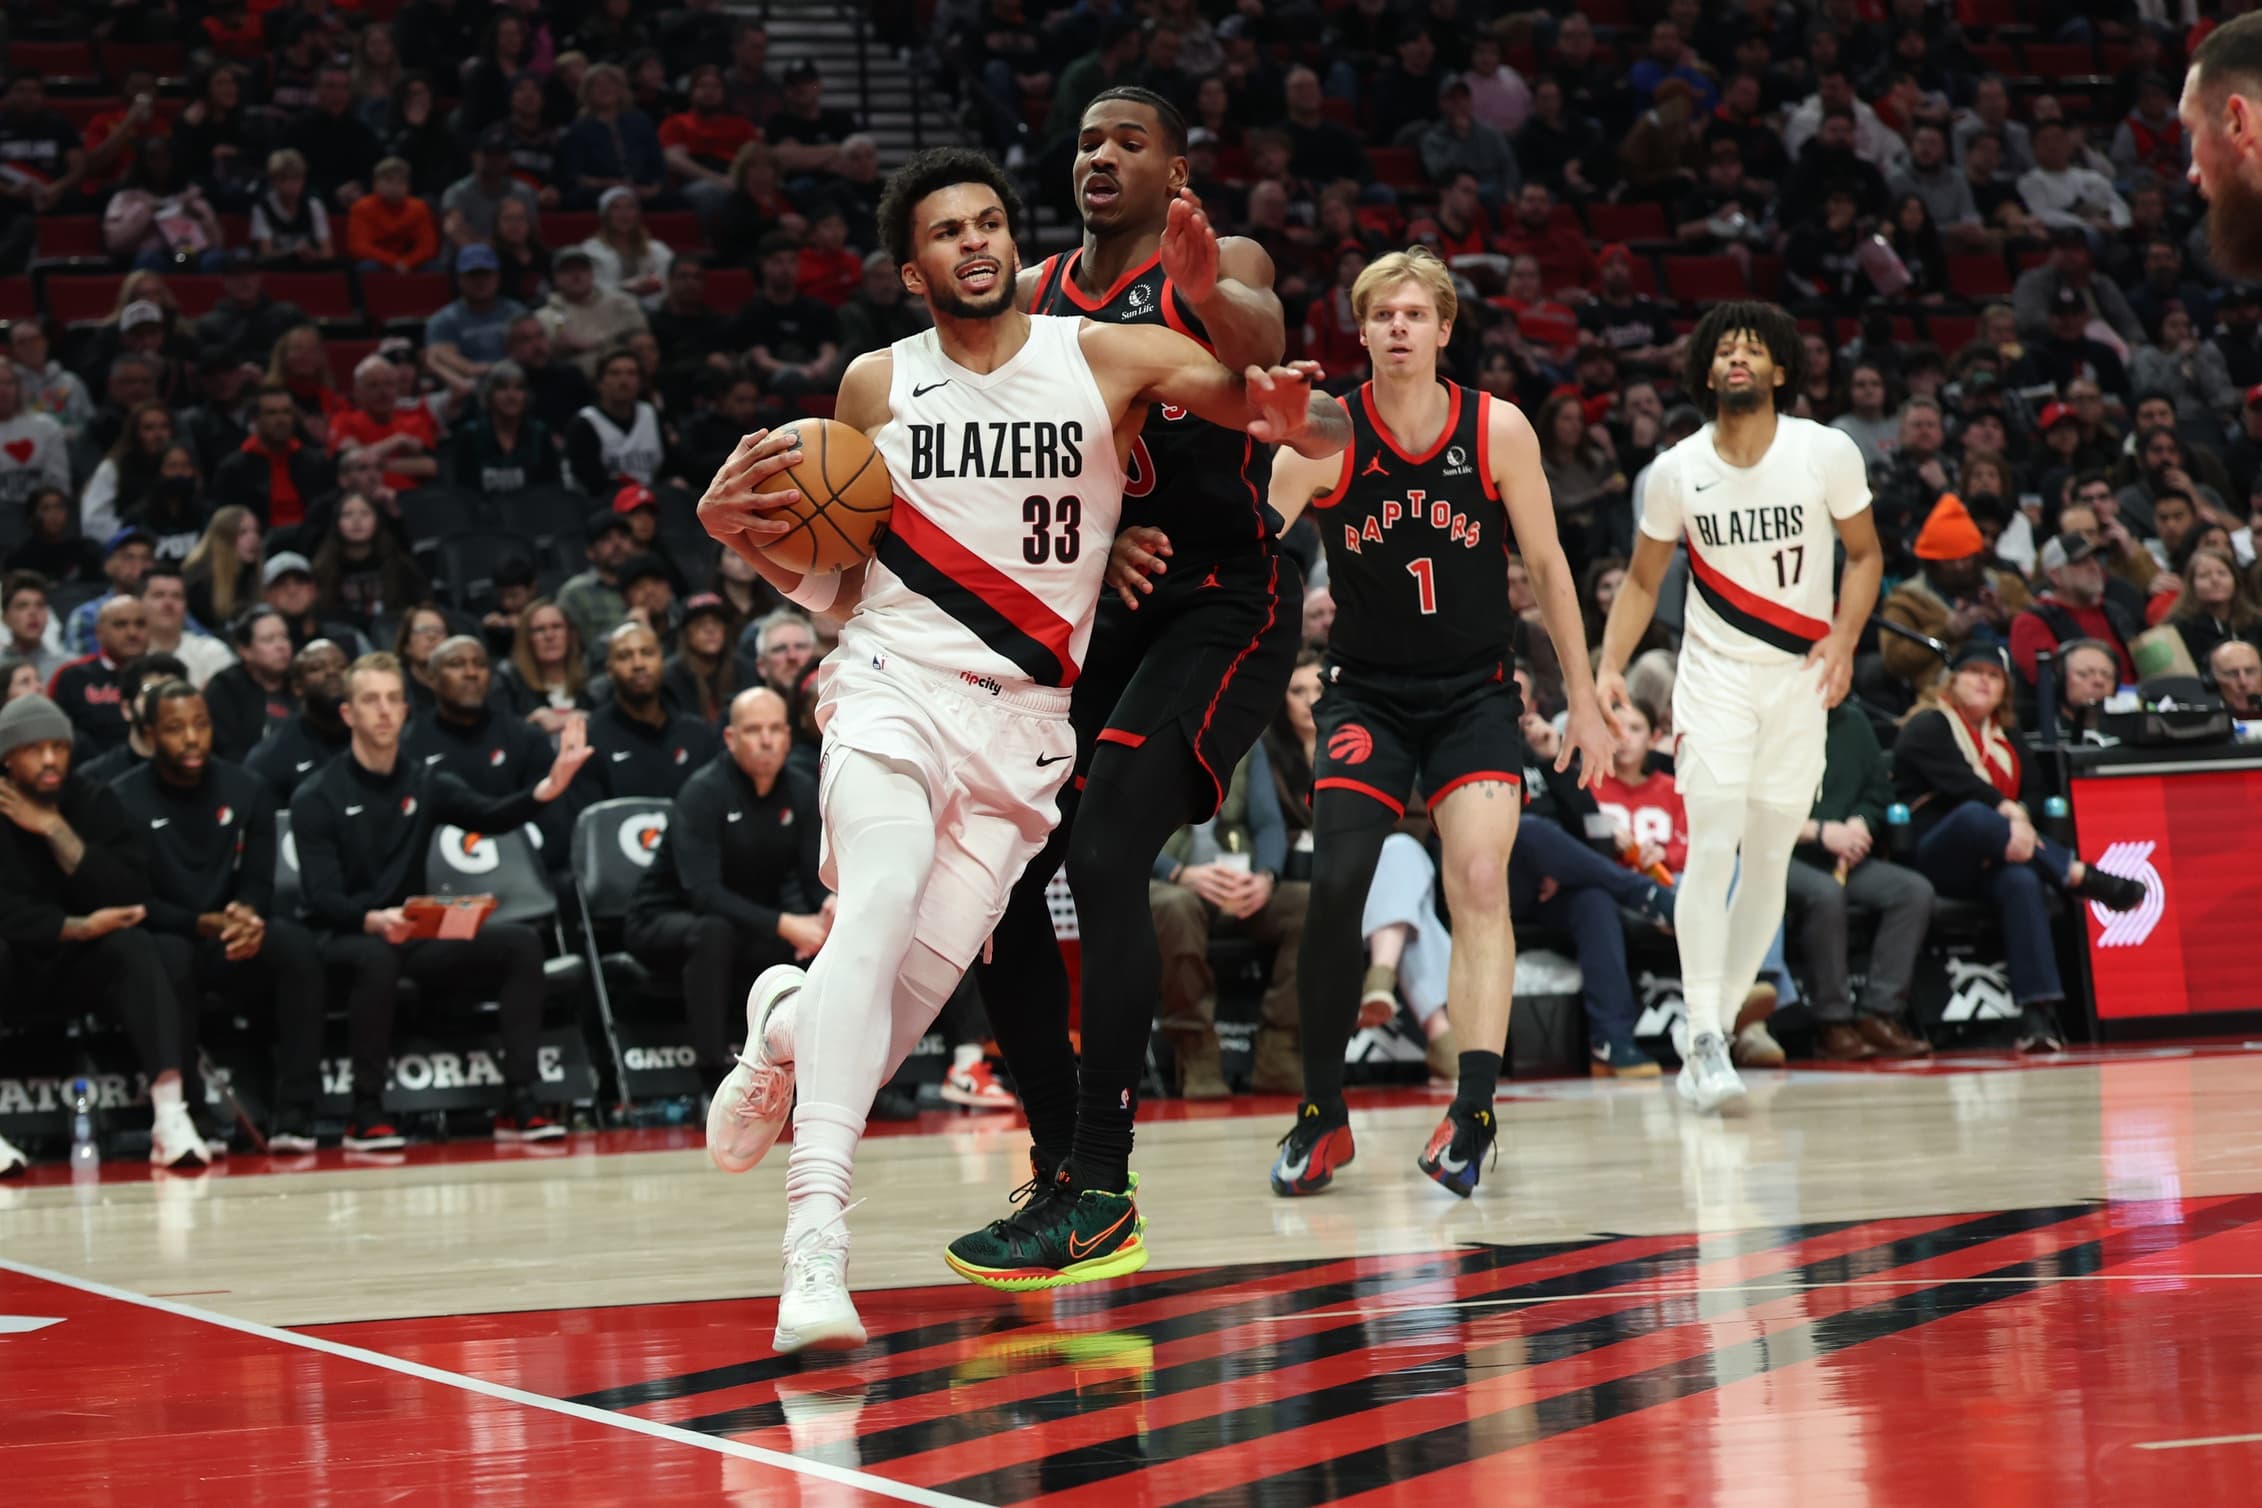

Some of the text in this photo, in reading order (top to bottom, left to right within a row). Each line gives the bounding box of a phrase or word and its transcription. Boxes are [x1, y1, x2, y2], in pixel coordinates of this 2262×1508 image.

[1121, 303, 1155, 320] Sun Life
[907, 421, 1083, 480] BLAZERS
[1442, 465, 1473, 477] Sun Life
[1022, 495, 1081, 564] 33
[1345, 490, 1481, 554] RAPTORS
[1694, 505, 1804, 546] BLAZERS
[1406, 557, 1437, 615] 1
[1771, 544, 1804, 588] 17
[960, 670, 1003, 696] ripcity
[624, 1045, 697, 1071] GATO
